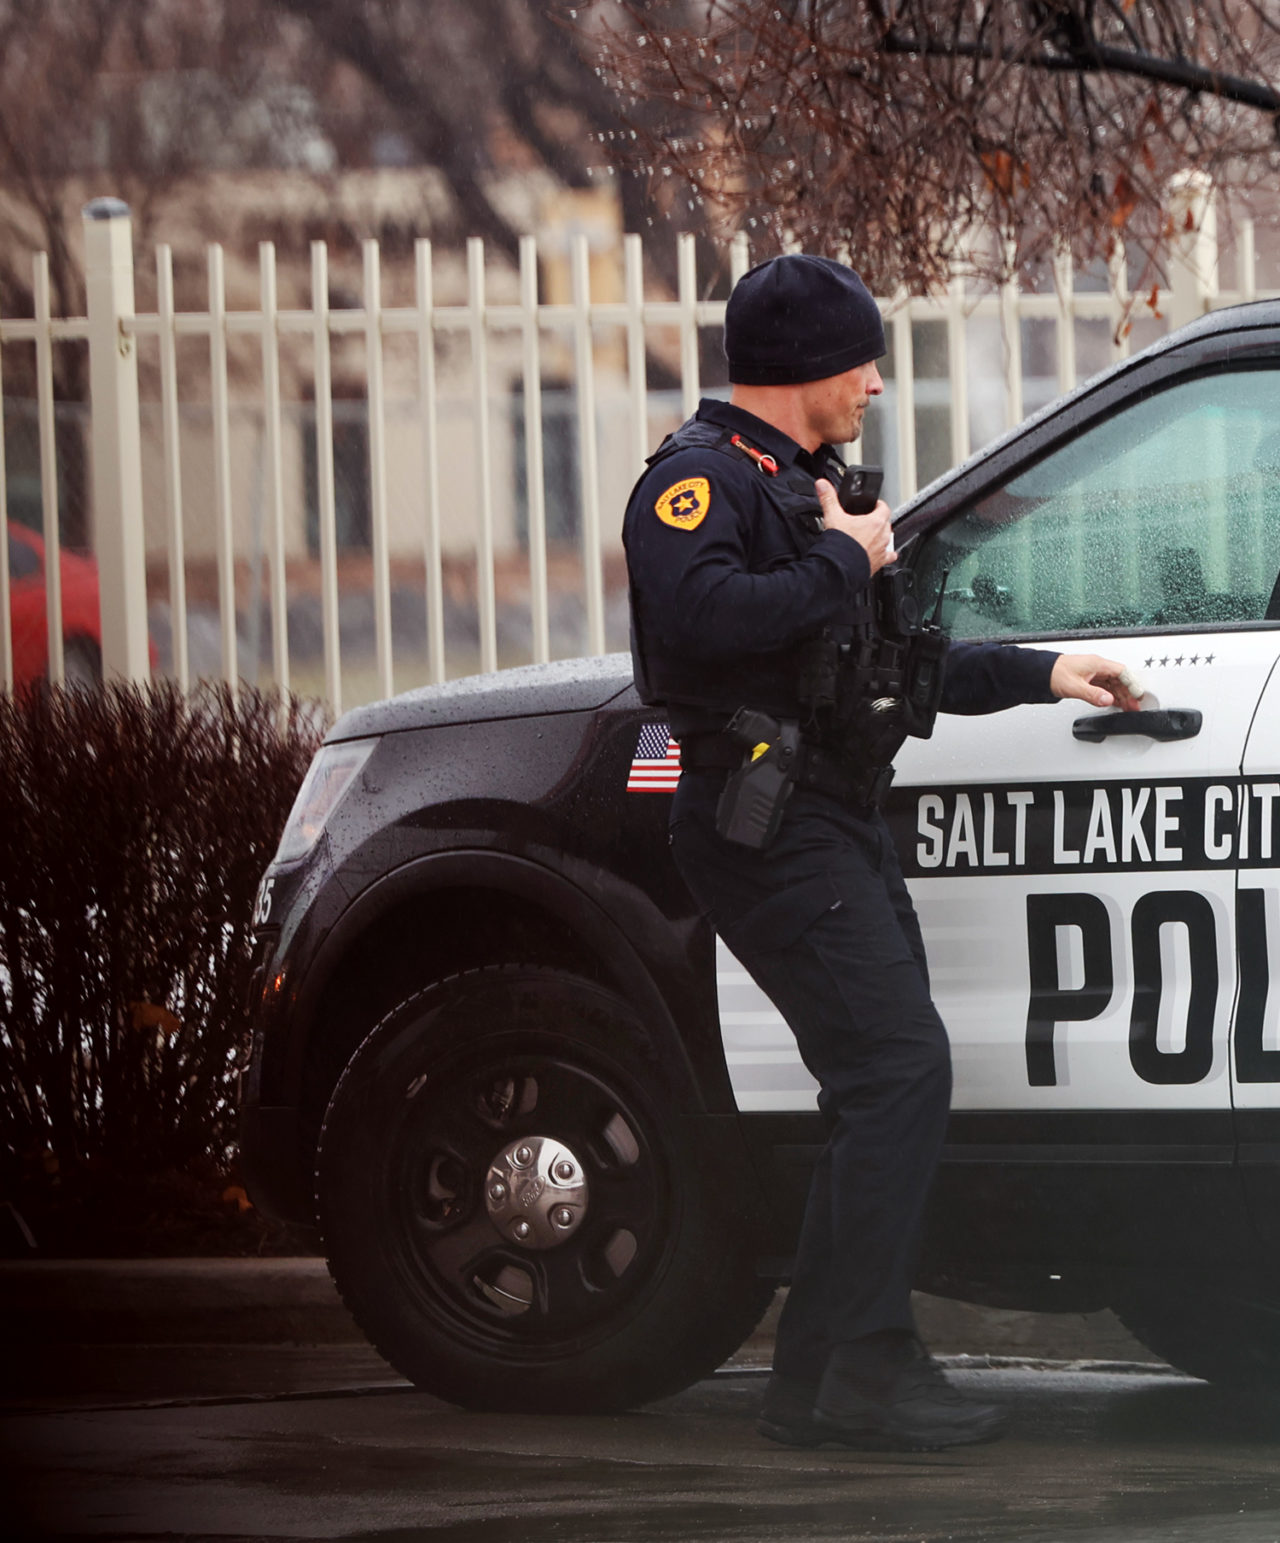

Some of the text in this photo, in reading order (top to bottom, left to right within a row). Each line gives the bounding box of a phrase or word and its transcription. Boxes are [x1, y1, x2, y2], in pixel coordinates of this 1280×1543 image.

[669, 483, 687, 497] LAKE
[688, 481, 704, 489] CITY
[675, 510, 703, 523] POLICE
[917, 791, 1034, 868] SALT
[1053, 786, 1184, 865] LAKE
